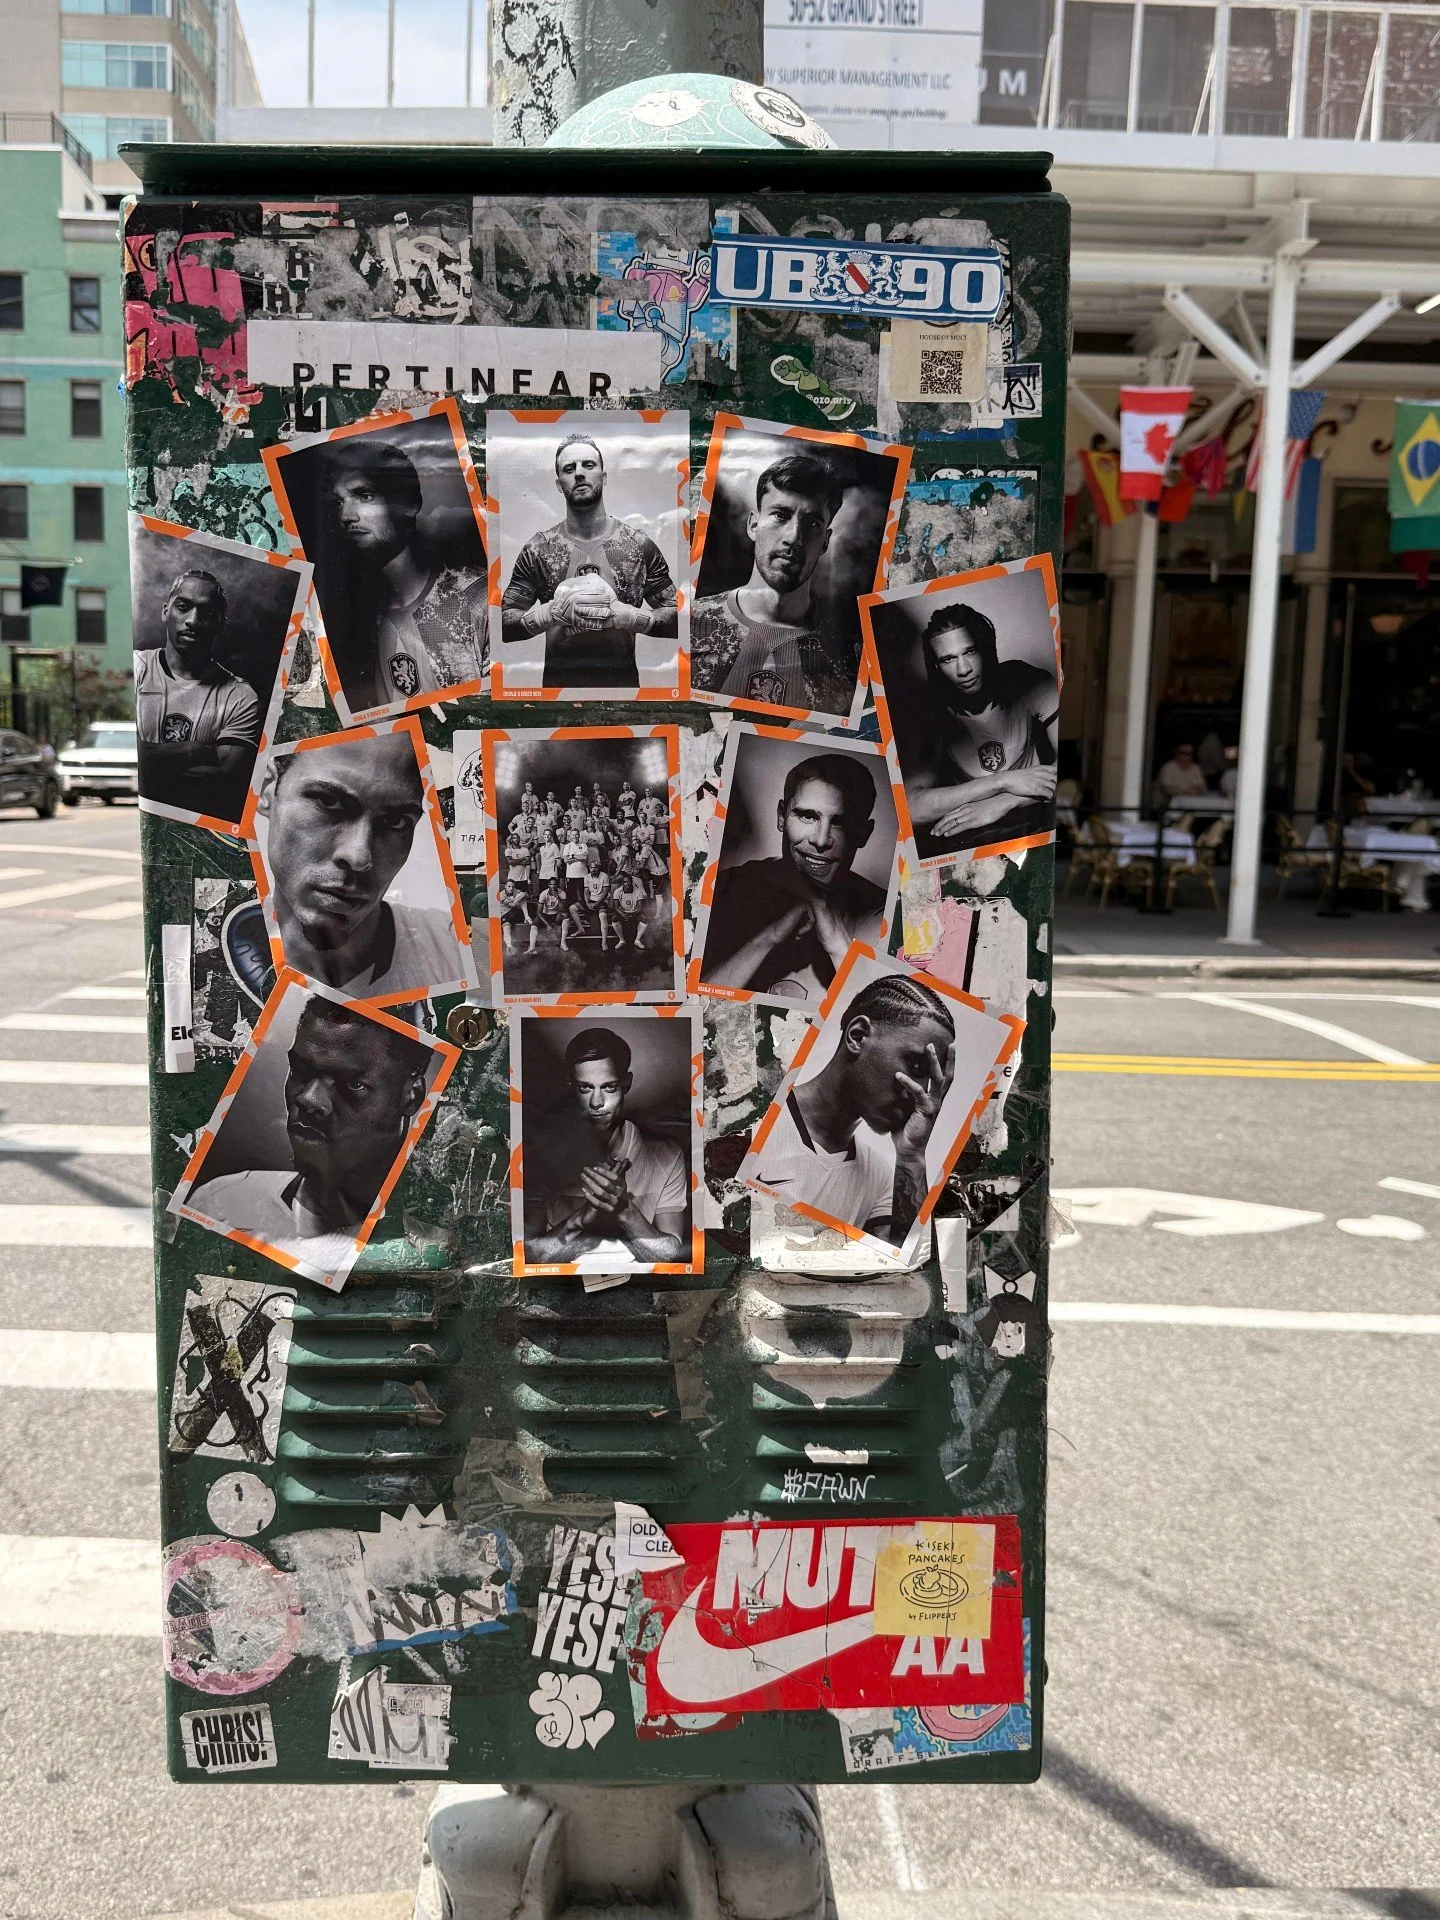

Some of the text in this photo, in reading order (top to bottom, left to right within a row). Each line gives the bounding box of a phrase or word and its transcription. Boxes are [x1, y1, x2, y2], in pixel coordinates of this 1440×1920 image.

[778, 67, 835, 86] SUPERIOR
[839, 69, 928, 90] MANAGEMENT
[715, 246, 1002, 312] UB 90
[460, 834, 485, 843] TRA
[632, 1523, 658, 1536] OLD
[915, 1539, 955, 1552] KISEKI
[908, 1554, 966, 1565] PANCAKES
[192, 1710, 268, 1768] CHRIS!
